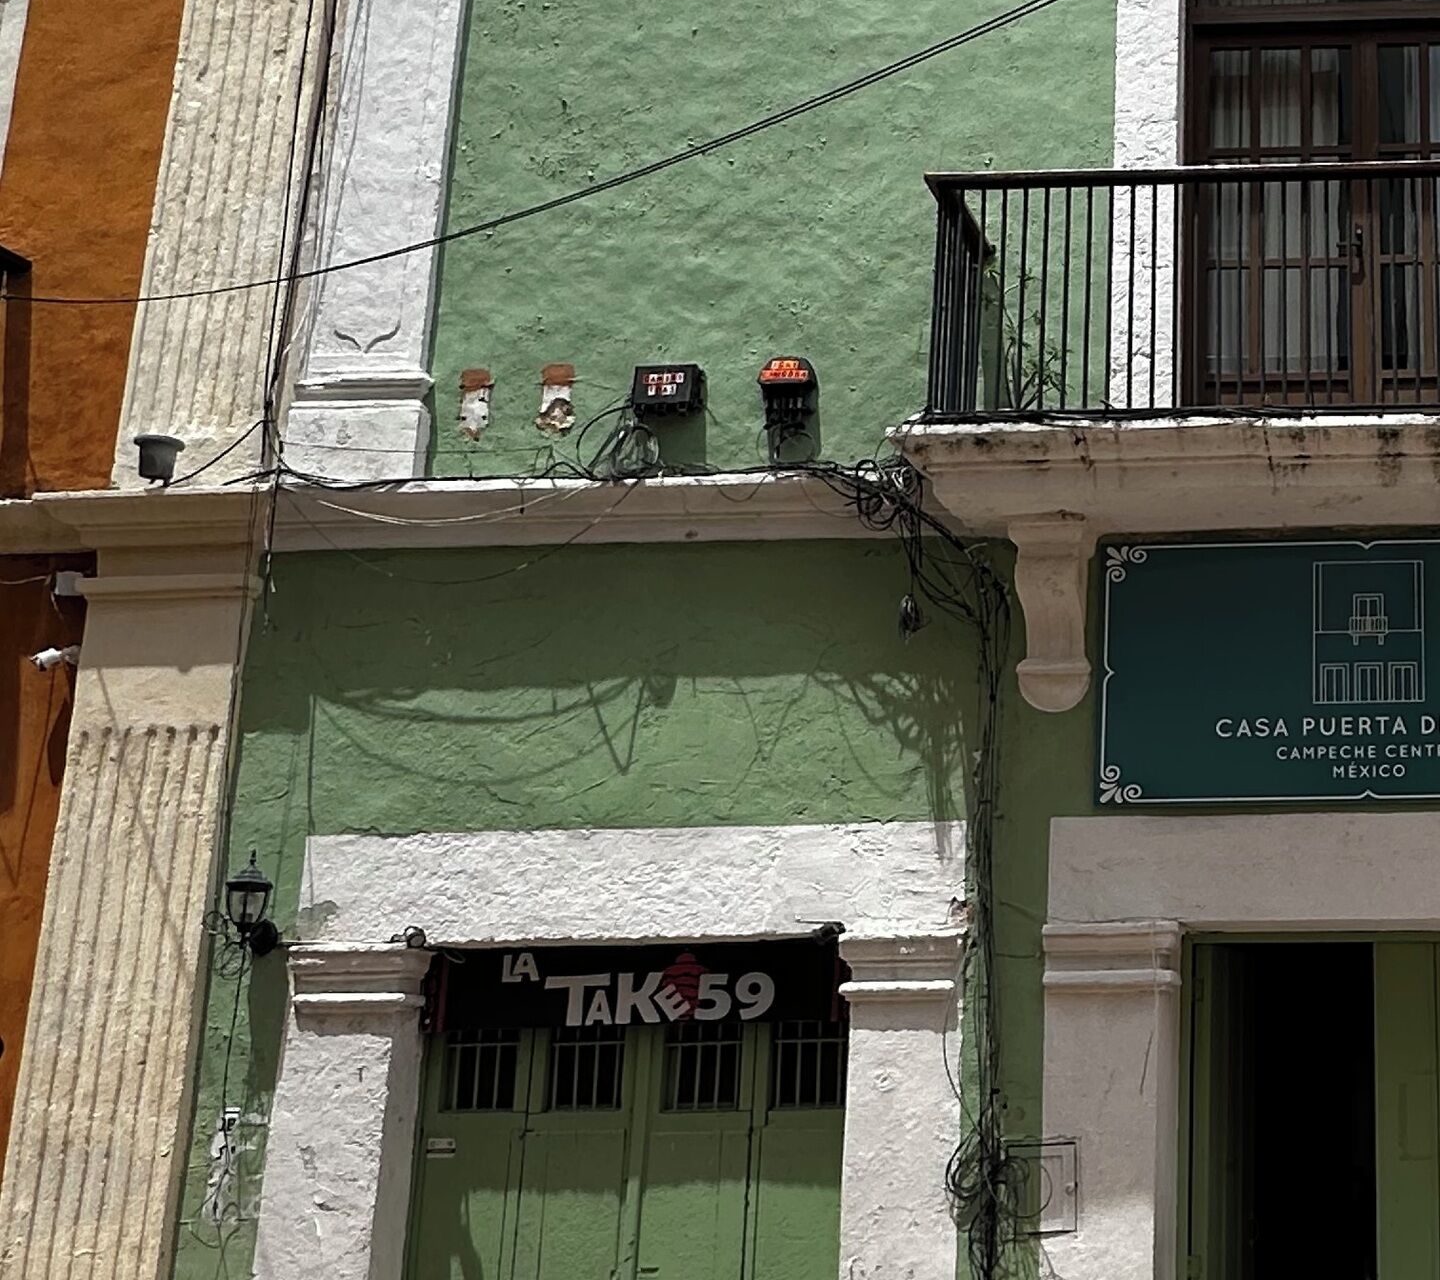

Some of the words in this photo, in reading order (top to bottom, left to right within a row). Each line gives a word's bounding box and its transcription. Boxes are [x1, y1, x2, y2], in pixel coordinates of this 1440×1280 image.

[1215, 718, 1289, 738] CASA
[1302, 716, 1407, 736] PUERTA
[1276, 745, 1376, 760] CAMPECHE
[1332, 761, 1406, 778] MÉXICO
[502, 952, 540, 983] LA
